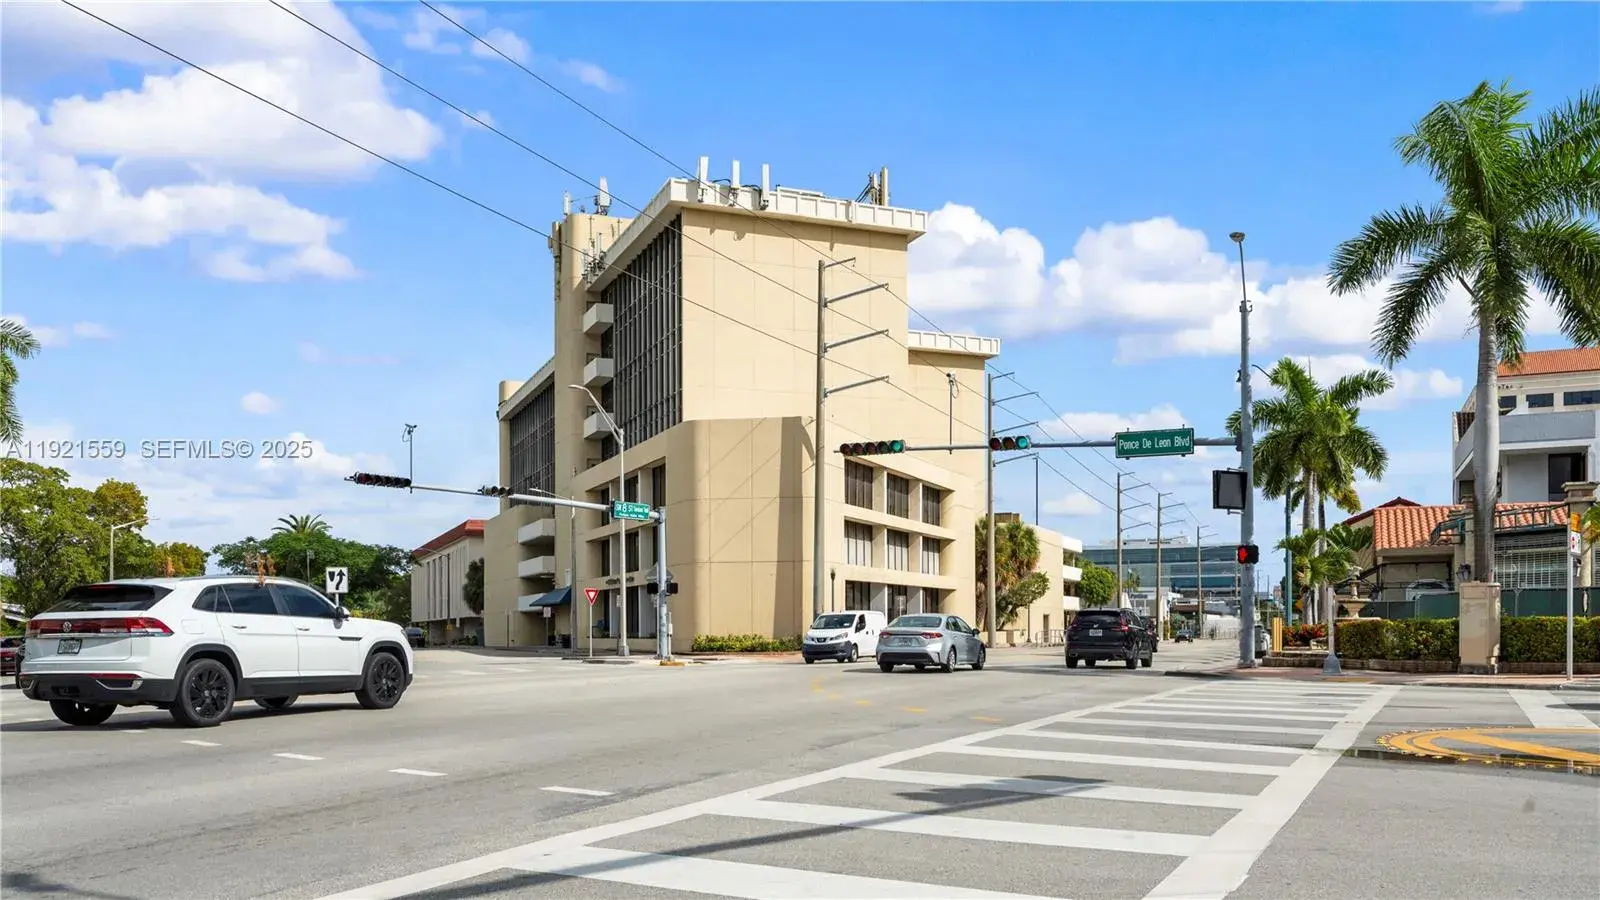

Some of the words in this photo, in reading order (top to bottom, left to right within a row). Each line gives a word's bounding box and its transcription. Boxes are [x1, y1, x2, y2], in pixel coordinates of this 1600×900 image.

[1120, 440, 1140, 450] Ponce
[1142, 438, 1152, 448] De
[1154, 437, 1172, 448] Leon
[1174, 436, 1190, 446] Blvd
[622, 502, 627, 513] 8
